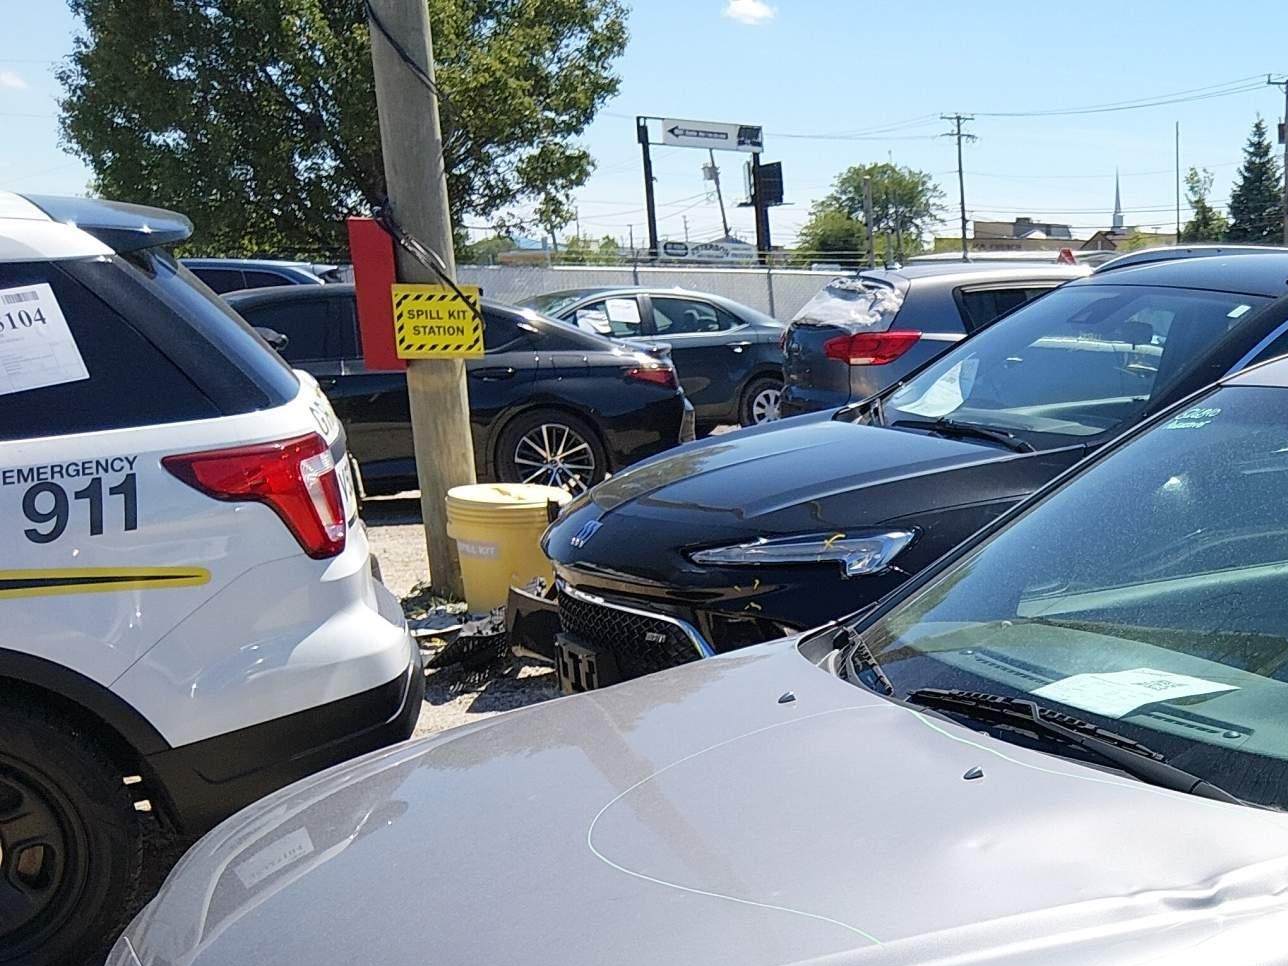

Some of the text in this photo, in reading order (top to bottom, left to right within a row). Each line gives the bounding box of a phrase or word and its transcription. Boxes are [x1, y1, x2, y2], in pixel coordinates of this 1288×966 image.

[407, 309, 467, 320] SPILL KIT
[412, 325, 464, 336] STATION
[2, 456, 138, 486] EMERGENCY
[22, 473, 138, 544] 911
